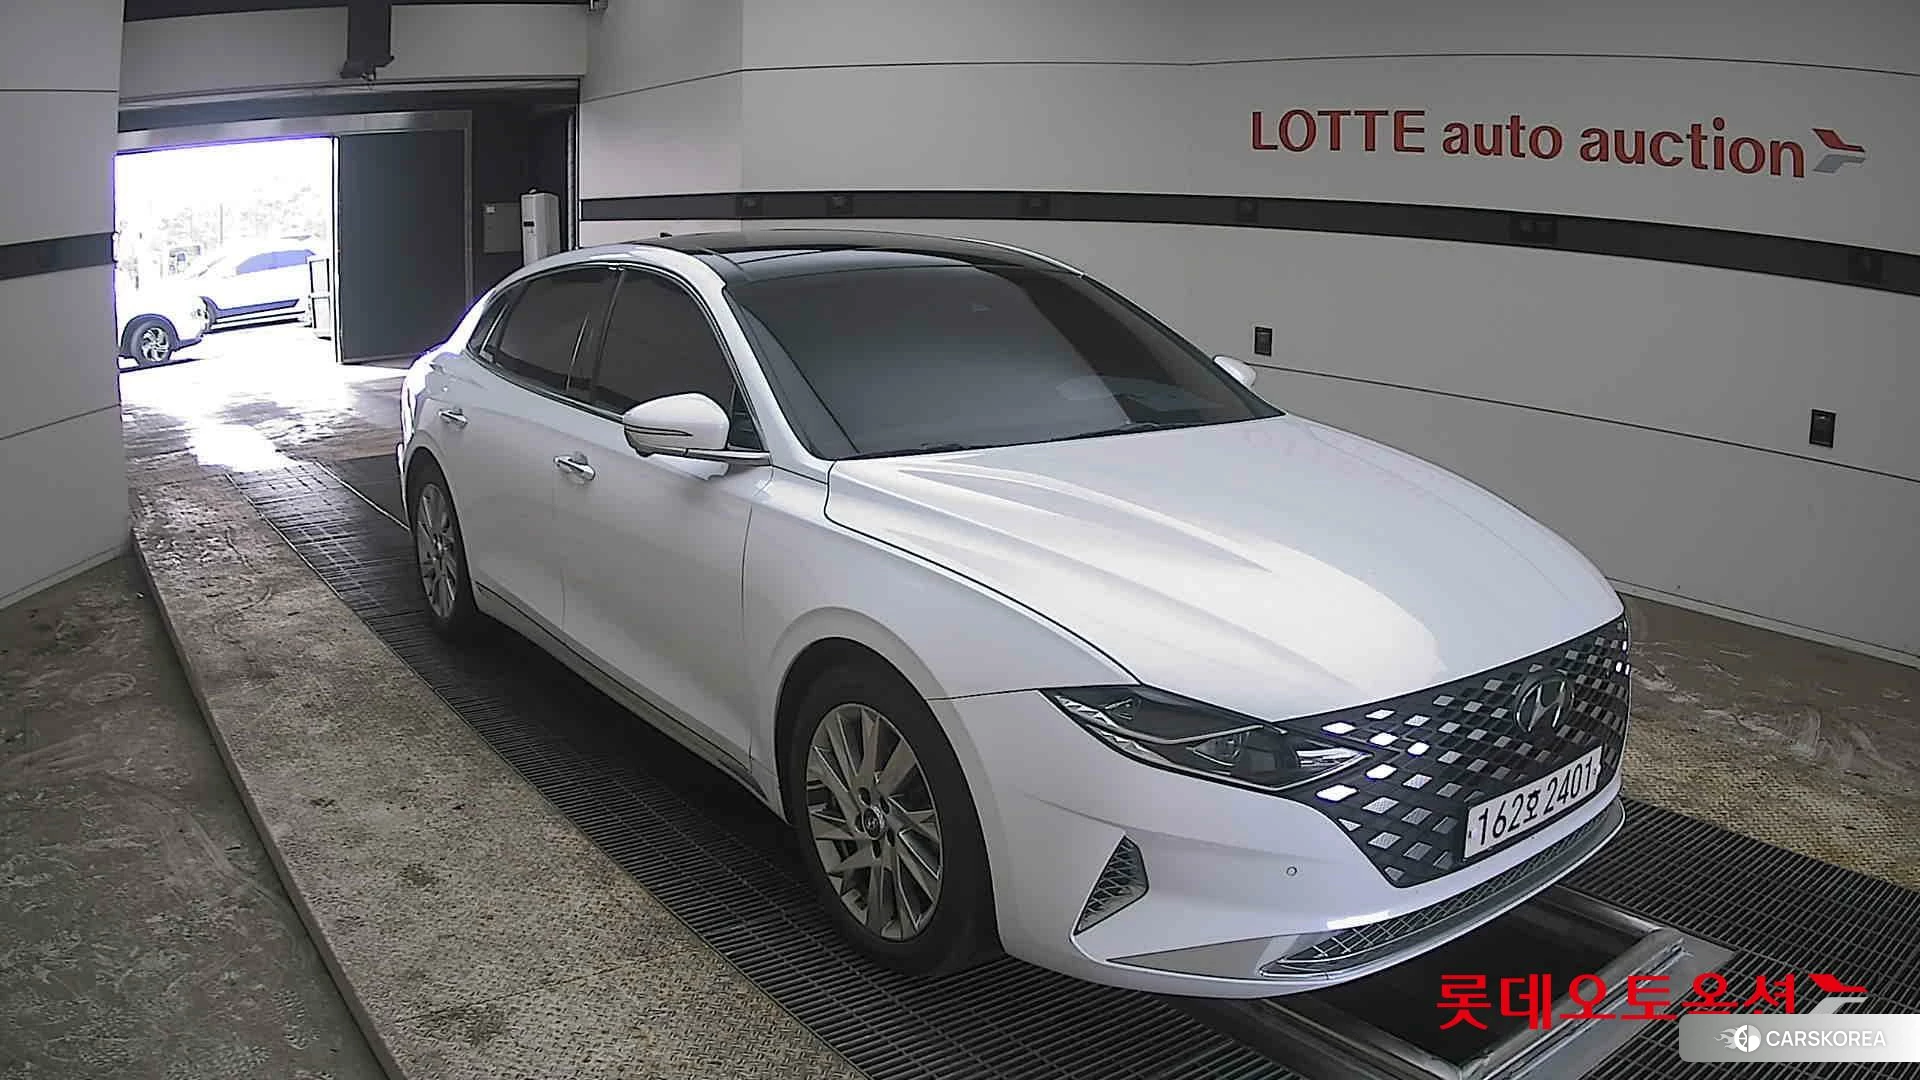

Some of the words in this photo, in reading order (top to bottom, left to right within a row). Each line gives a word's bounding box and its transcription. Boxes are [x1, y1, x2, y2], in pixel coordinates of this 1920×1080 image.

[1251, 108, 1426, 153] LOTTE
[1442, 114, 1563, 160] auto
[1579, 116, 1806, 178] auction
[1543, 756, 1593, 815] 2401
